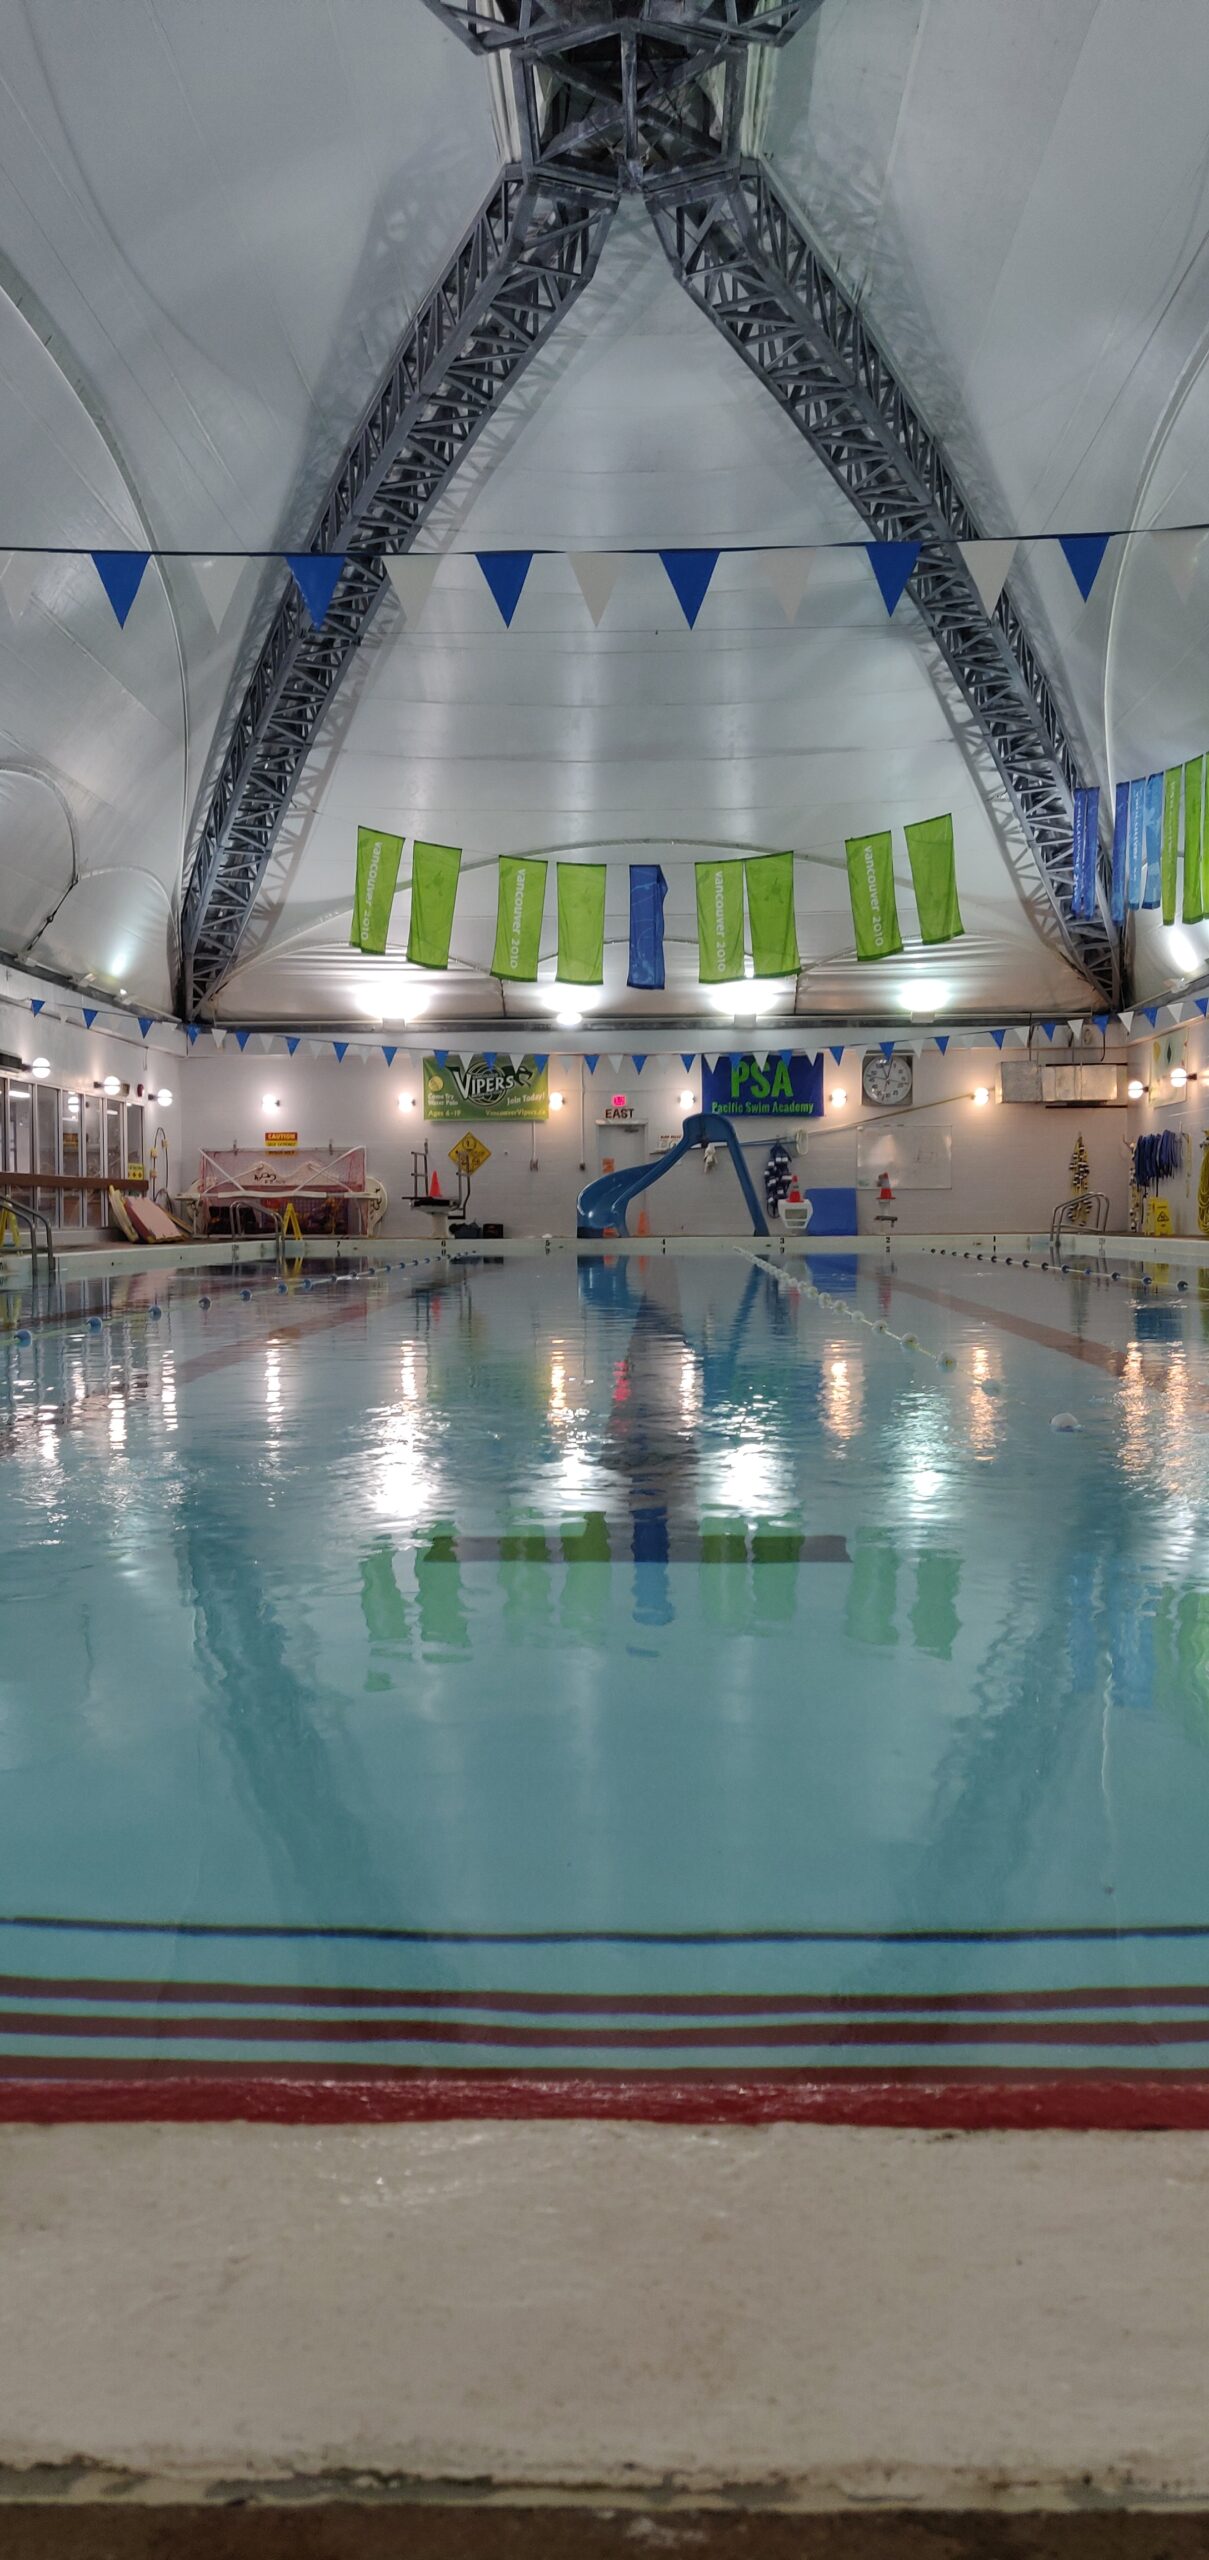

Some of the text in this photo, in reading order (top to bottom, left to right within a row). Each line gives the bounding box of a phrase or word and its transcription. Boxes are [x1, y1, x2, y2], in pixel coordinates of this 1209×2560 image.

[864, 845, 884, 947] vancouver 2010
[510, 868, 527, 970] vancouver 2010
[714, 870, 727, 973] vancouver 2010
[452, 1070, 515, 1100] VIPERS
[731, 1059, 794, 1099] PSA
[507, 1095, 521, 1106] Join
[605, 1108, 635, 1119] EAST
[711, 1101, 814, 1114] Pacific Swim Academy
